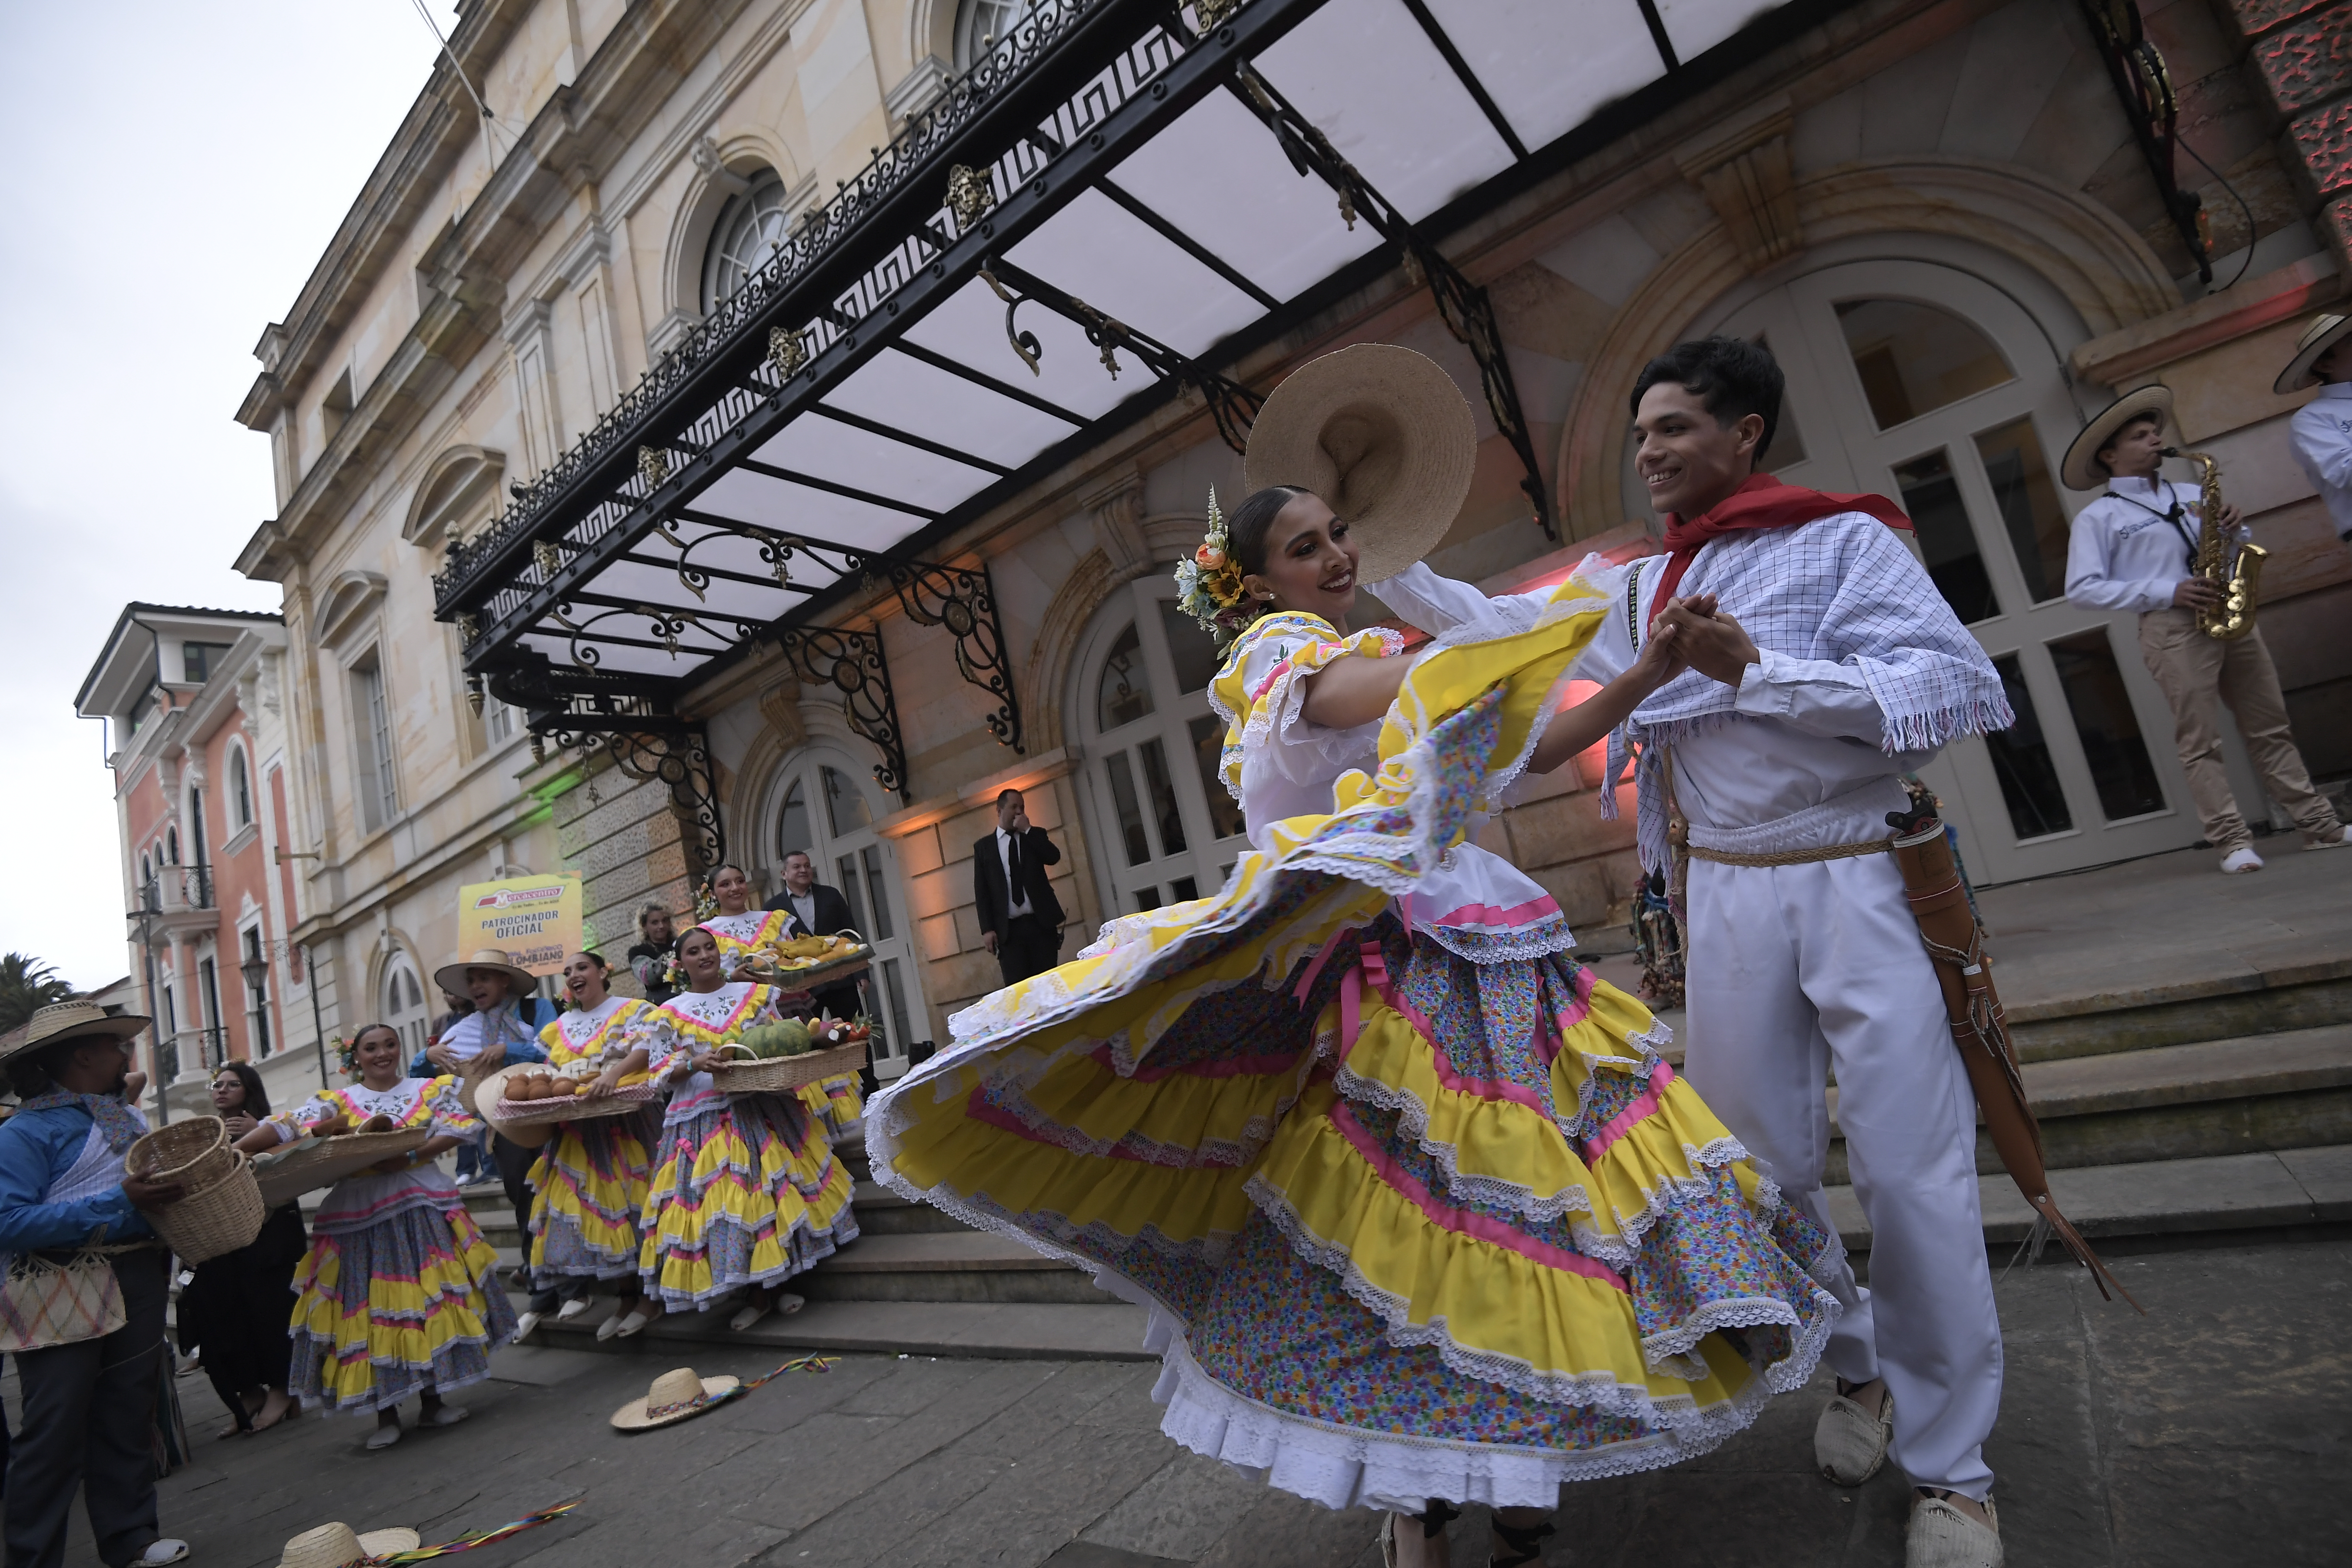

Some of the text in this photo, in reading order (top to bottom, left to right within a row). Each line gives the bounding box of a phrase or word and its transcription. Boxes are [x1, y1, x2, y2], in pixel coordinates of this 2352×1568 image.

[496, 888, 558, 904] Mercacentro
[482, 910, 558, 929] PATROCINADOR
[496, 923, 543, 938] OFICIAL
[508, 950, 564, 966] LOMBIANO
